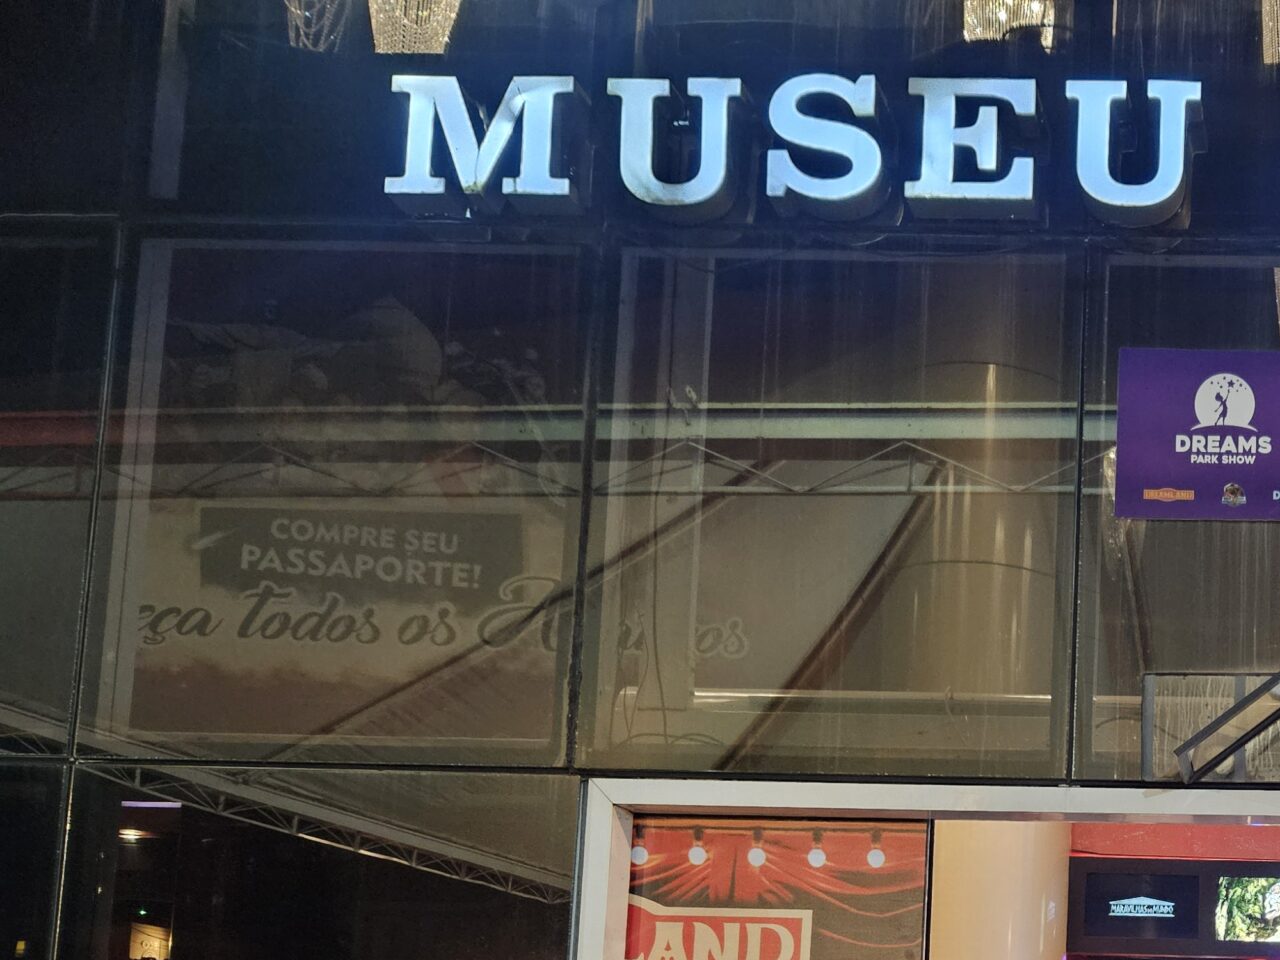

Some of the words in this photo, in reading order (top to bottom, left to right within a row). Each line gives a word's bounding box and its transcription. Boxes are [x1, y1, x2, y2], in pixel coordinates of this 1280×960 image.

[384, 72, 1204, 208] MUSEU
[1175, 434, 1272, 455] DREAMS
[1190, 454, 1219, 465] PARK
[1221, 454, 1256, 465] SHOW
[269, 517, 395, 546] COMPRE
[406, 526, 459, 556] SEU
[240, 542, 483, 590] PASSAPORTE!
[235, 579, 385, 645] todos
[397, 600, 457, 647] os
